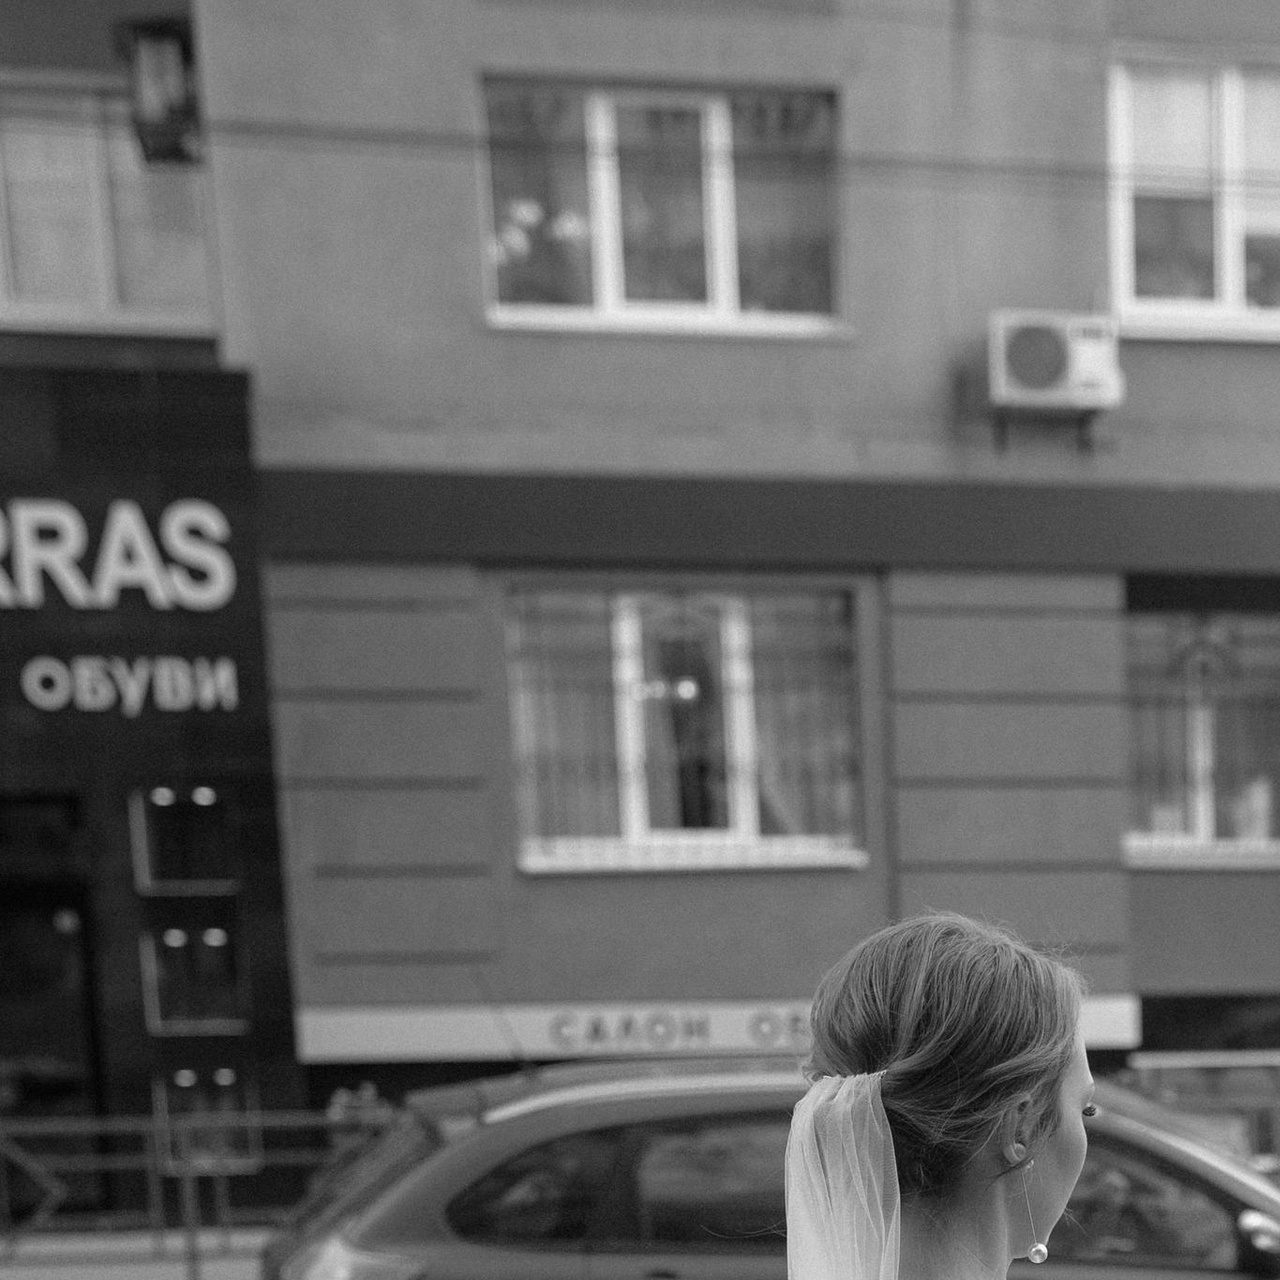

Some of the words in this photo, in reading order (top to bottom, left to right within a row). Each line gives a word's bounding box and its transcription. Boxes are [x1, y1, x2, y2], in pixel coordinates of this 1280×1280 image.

[0, 499, 237, 611] RAS
[20, 655, 239, 718] ОБУВИ
[550, 1008, 710, 1047] САЛОН
